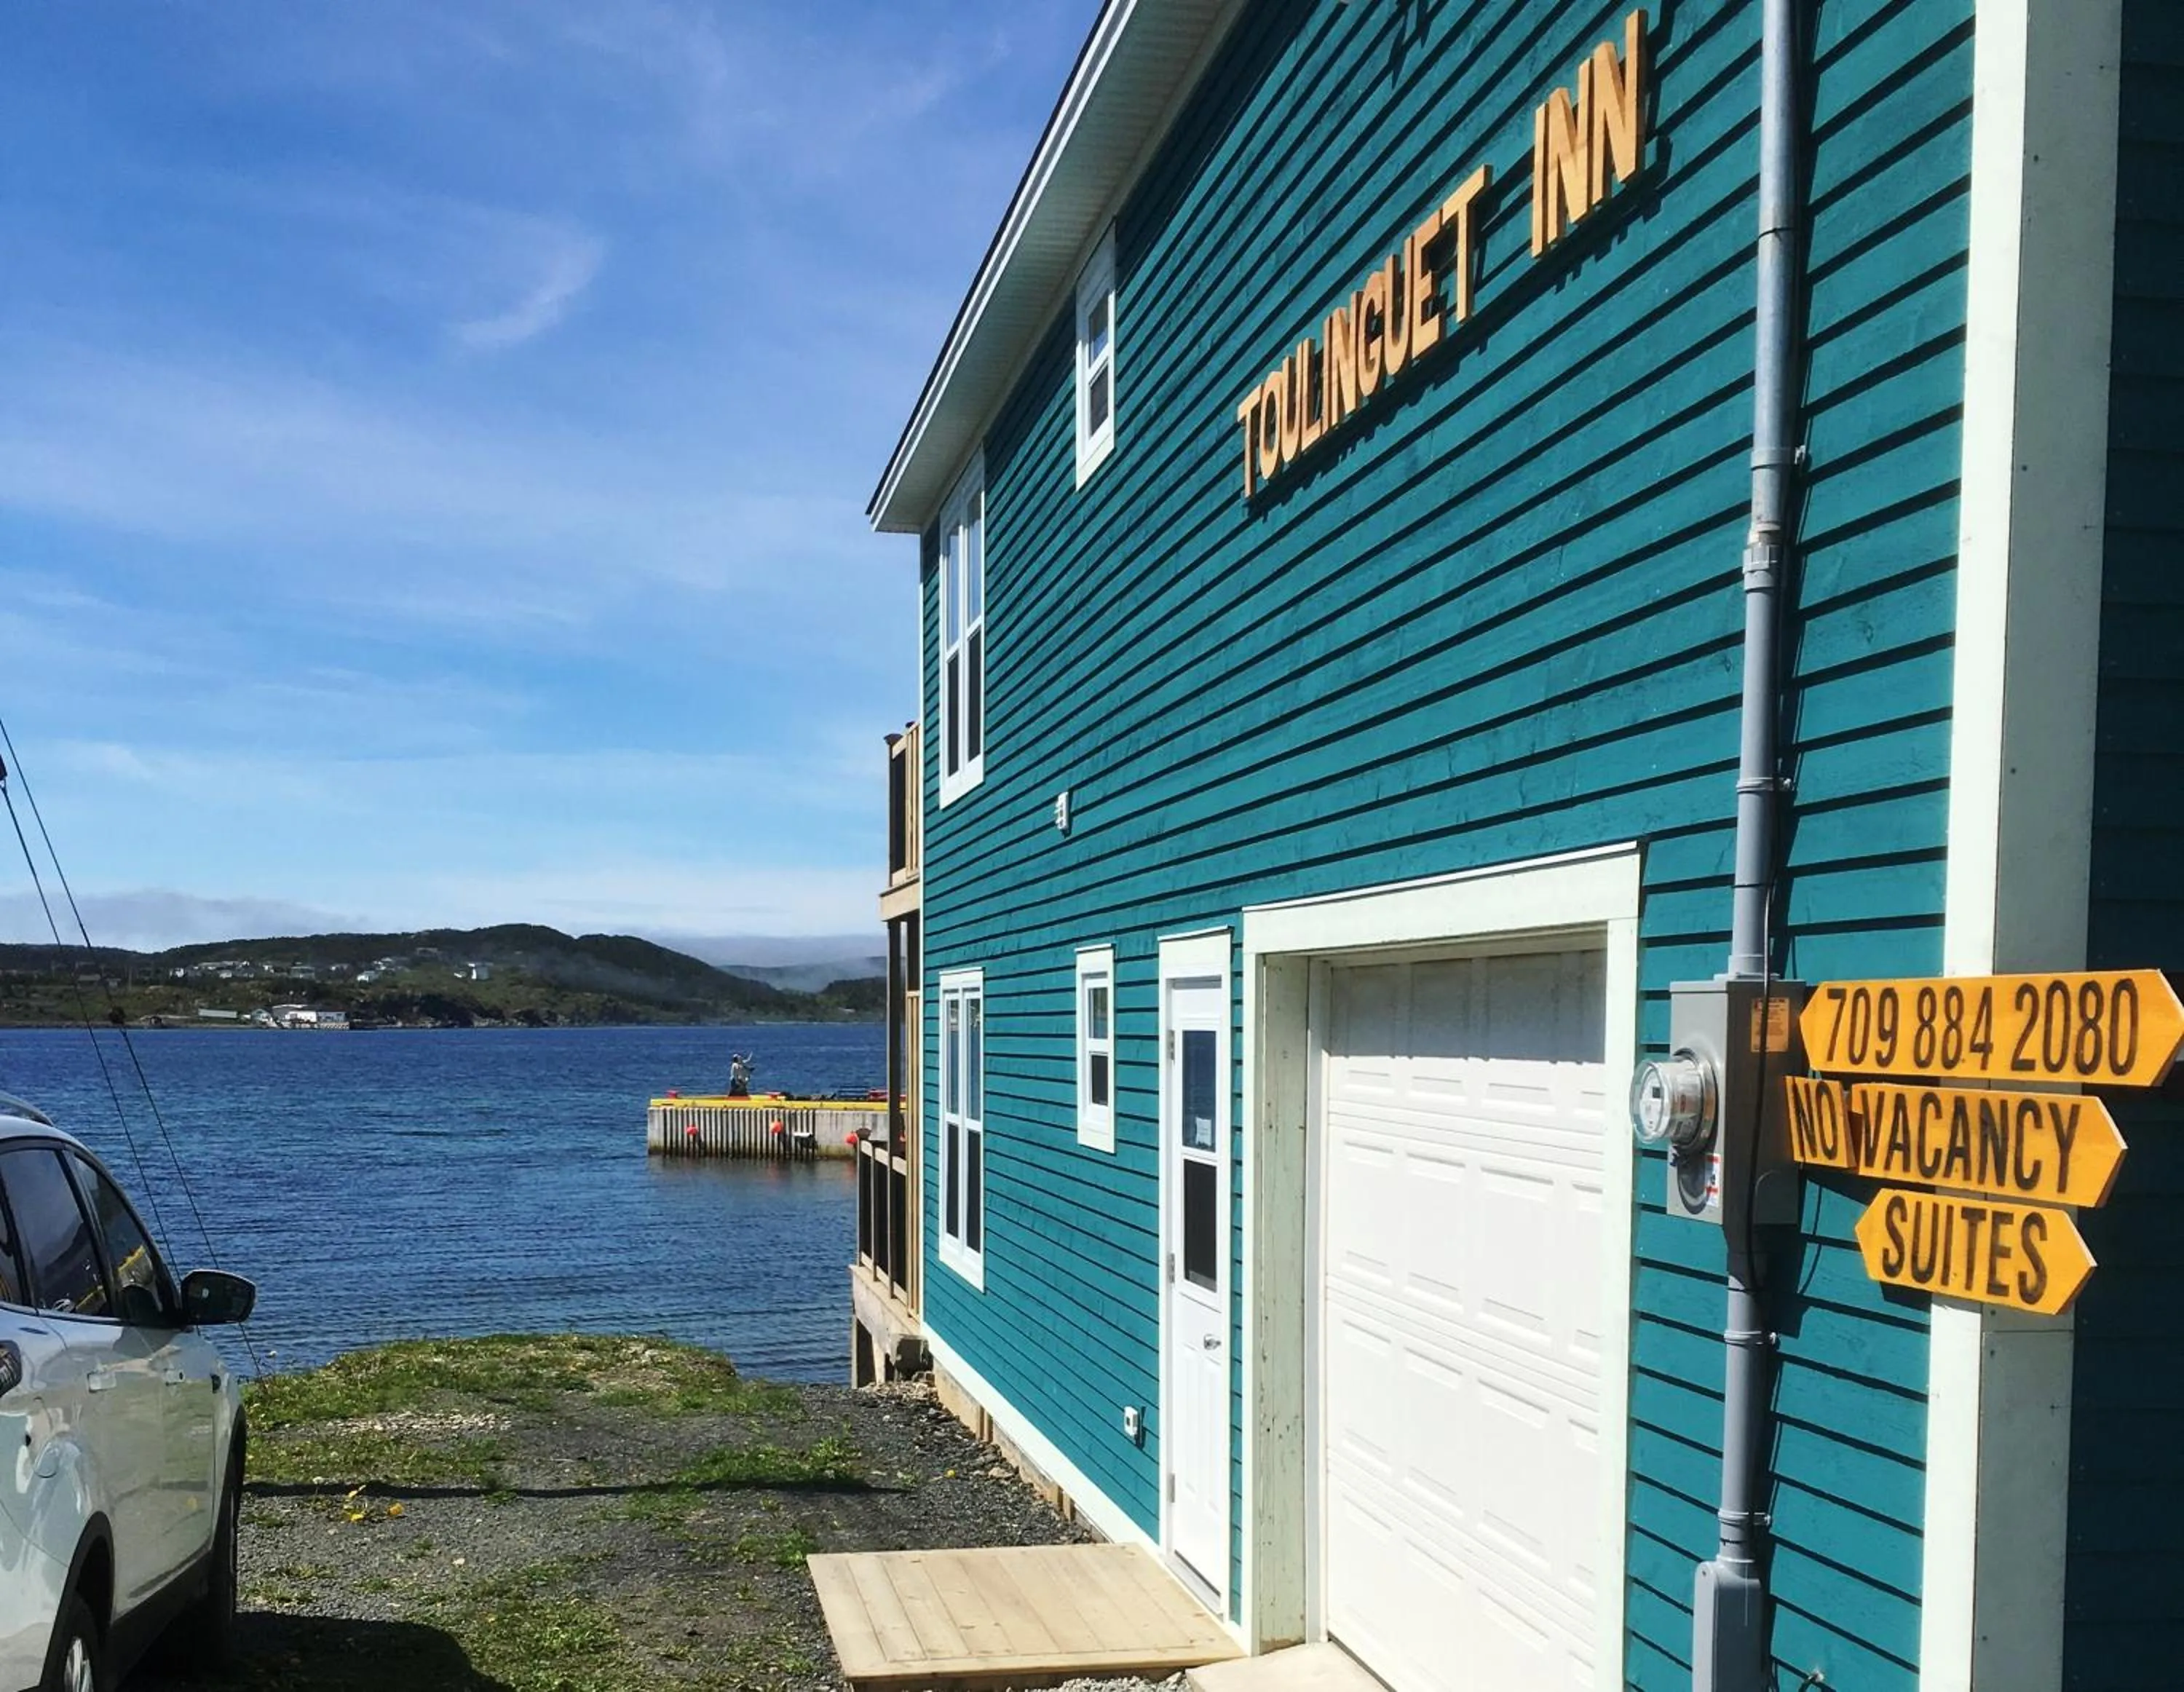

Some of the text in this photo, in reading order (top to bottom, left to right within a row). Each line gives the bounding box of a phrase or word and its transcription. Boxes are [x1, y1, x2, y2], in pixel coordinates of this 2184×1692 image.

[1237, 9, 1647, 499] TOULINGUET INN
[1826, 987, 1900, 1068] 709
[1913, 985, 1994, 1072] 884
[2009, 978, 2140, 1076] 2080
[1790, 1080, 2082, 1195] NO VACANCY
[1881, 1195, 2049, 1305] SUITES
